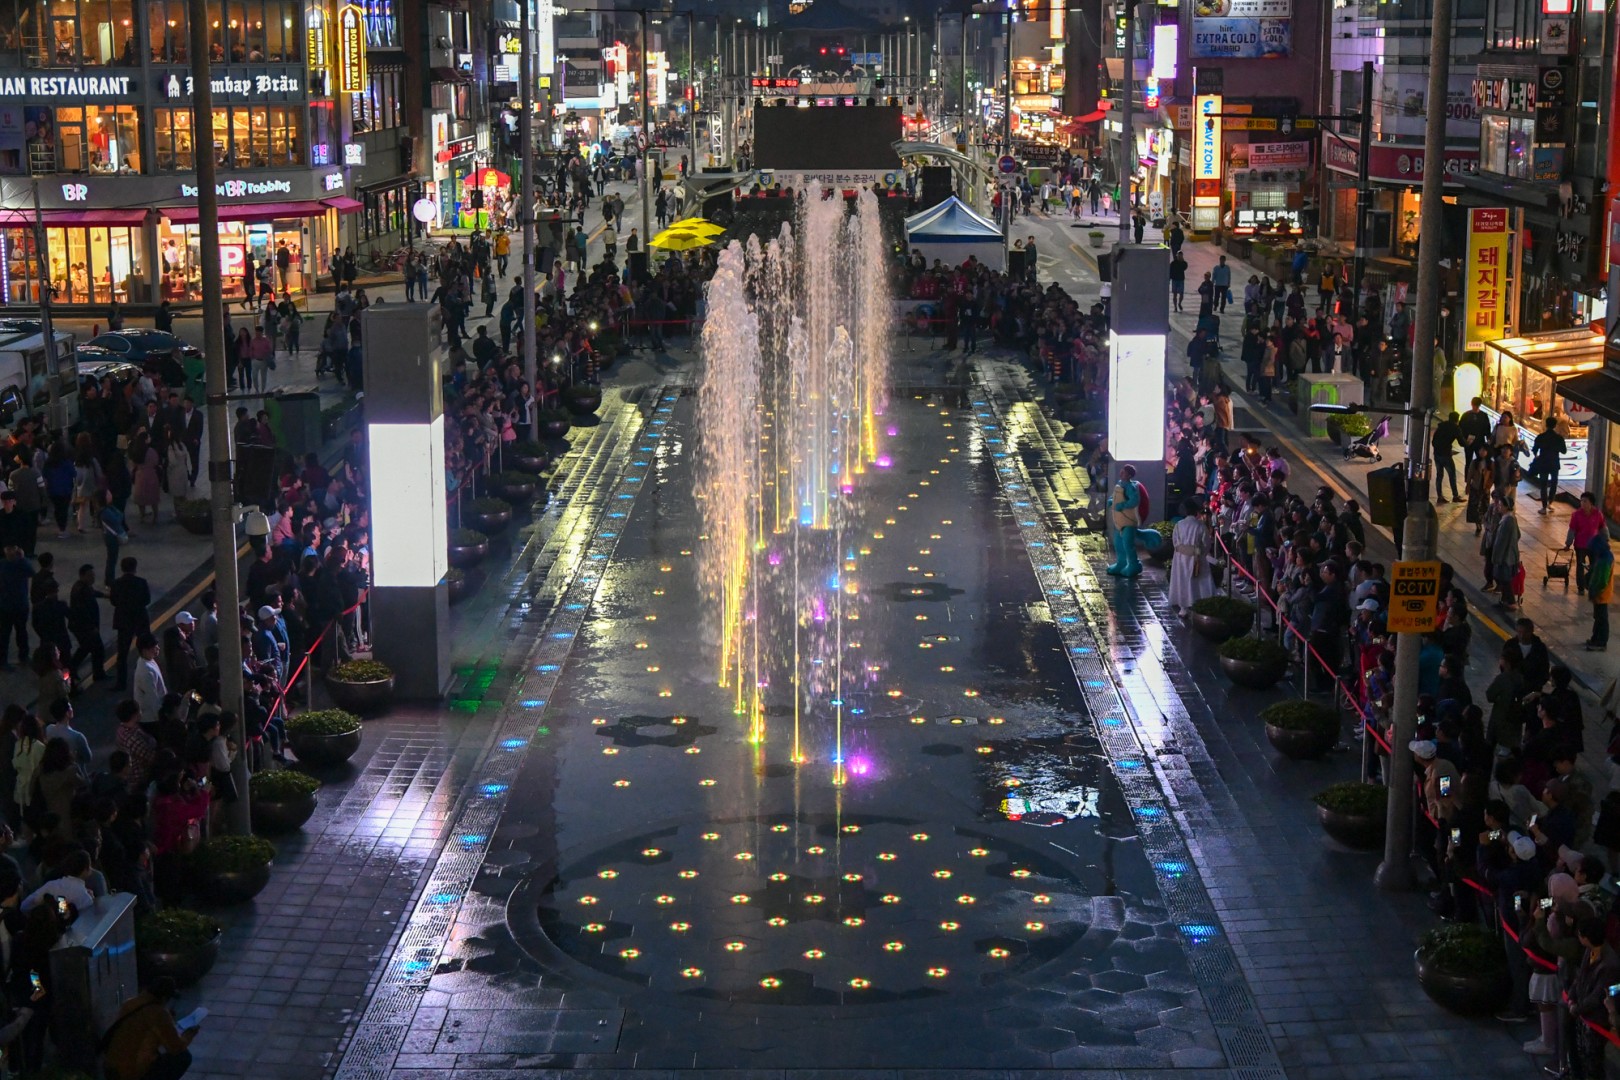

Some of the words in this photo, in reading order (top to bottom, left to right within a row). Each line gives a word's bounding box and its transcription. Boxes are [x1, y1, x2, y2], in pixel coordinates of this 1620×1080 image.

[1196, 33, 1228, 44] EXTRA
[1230, 33, 1256, 44] COLD
[1263, 27, 1285, 35] EXTRA
[1265, 35, 1284, 43] COLD
[350, 28, 358, 64] BOMBAY
[30, 76, 130, 95] RESTAURANT
[185, 76, 252, 96] mbay
[255, 75, 299, 94] Bräu
[351, 66, 360, 90] BRÄU
[345, 144, 362, 156] BR
[1204, 149, 1213, 175] ZONE
[1414, 157, 1480, 175] BGER
[62, 183, 88, 201] BR
[225, 180, 247, 197] BR
[247, 180, 291, 194] robbins
[1475, 246, 1500, 330] 돼지갈비
[1397, 582, 1433, 594] CCTV
